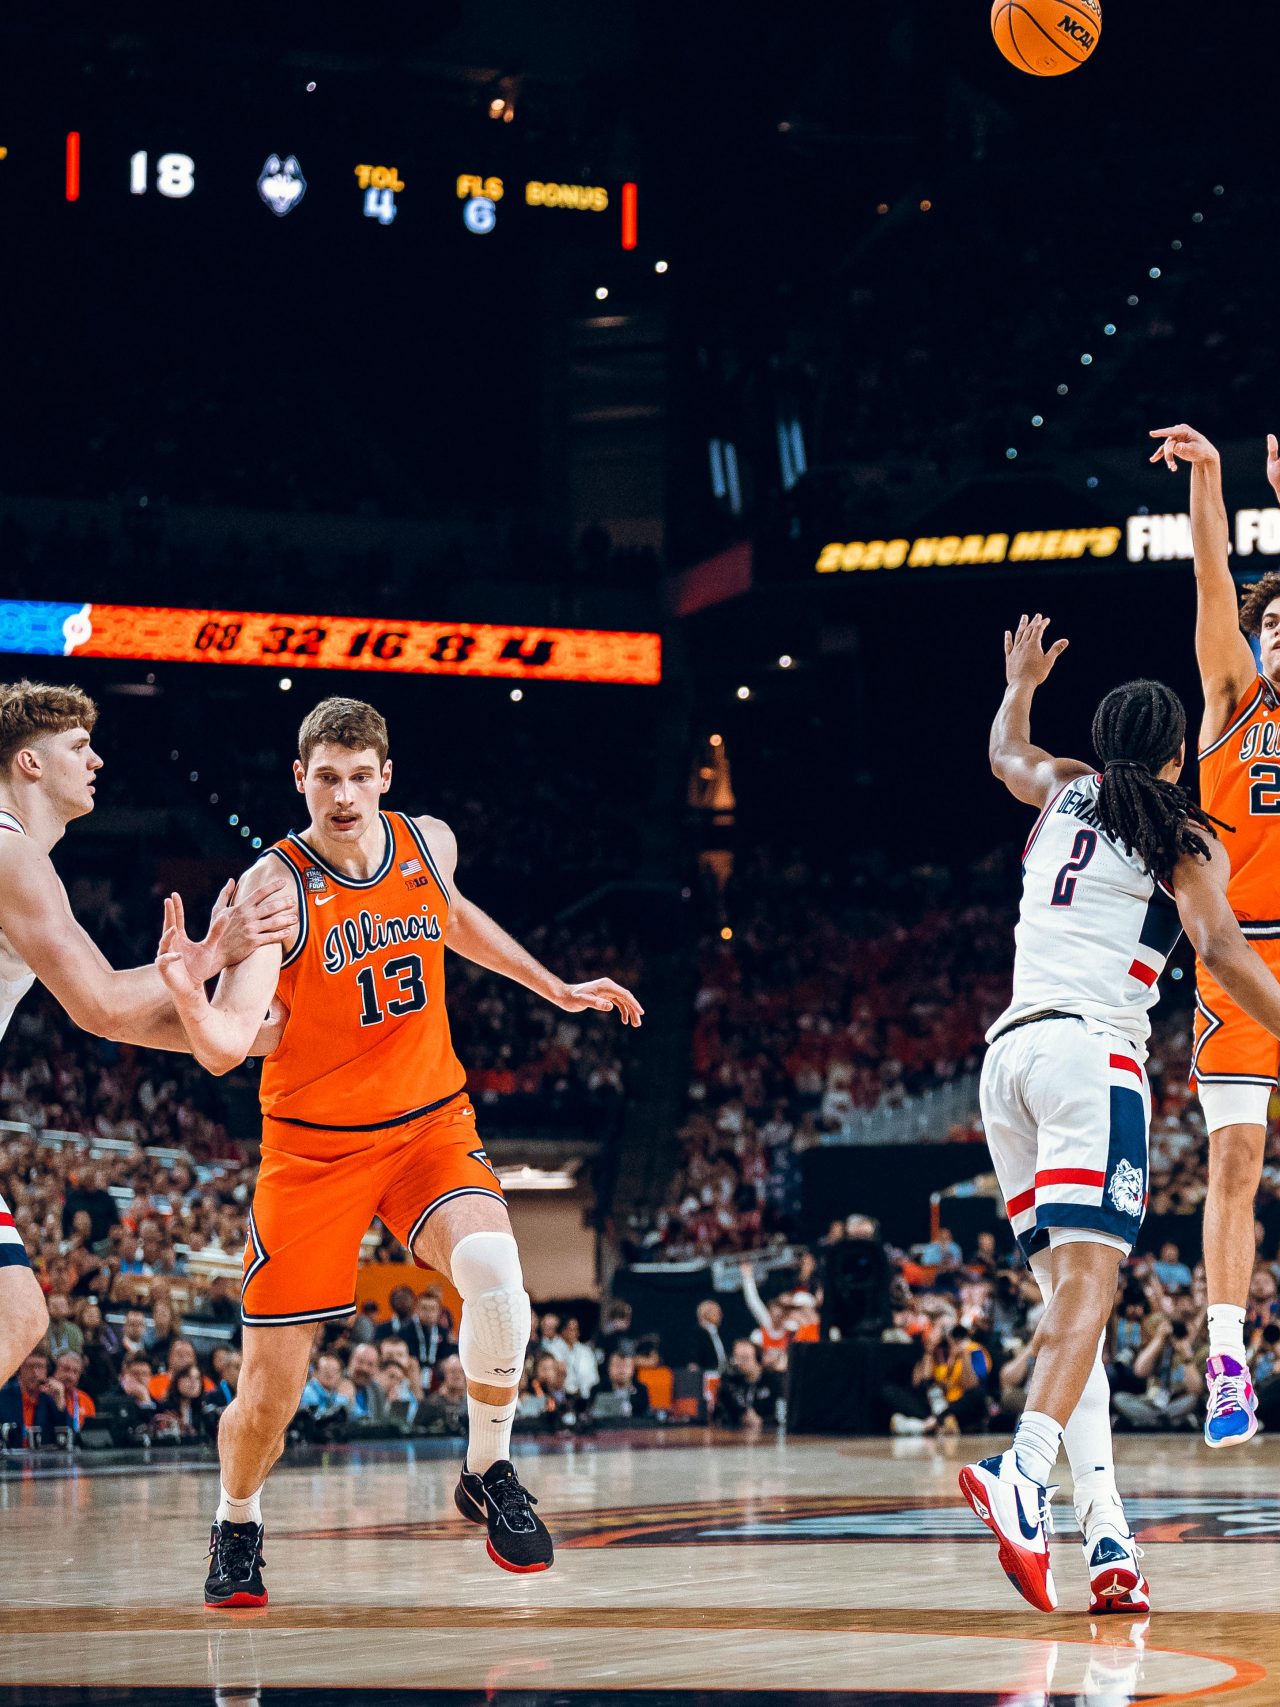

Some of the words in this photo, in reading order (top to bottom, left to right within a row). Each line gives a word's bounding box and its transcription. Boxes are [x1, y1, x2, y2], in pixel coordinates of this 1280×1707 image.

[1057, 15, 1094, 51] NCAA
[130, 151, 195, 198] 18
[354, 164, 405, 192] TOL
[456, 174, 504, 202] FLS
[364, 188, 397, 225] 4
[463, 197, 496, 234] 6
[525, 181, 609, 212] BONUS
[907, 533, 1009, 568] NCAA
[1008, 526, 1121, 562] MEN'S
[1127, 513, 1232, 562] FIN
[261, 626, 327, 656] 32
[346, 631, 408, 659] 16
[430, 635, 476, 662] 8
[499, 639, 555, 666] 4
[1056, 790, 1106, 831] DEMA
[1050, 829, 1098, 906] 2
[323, 905, 441, 974] Illinois
[356, 954, 428, 1027] 13
